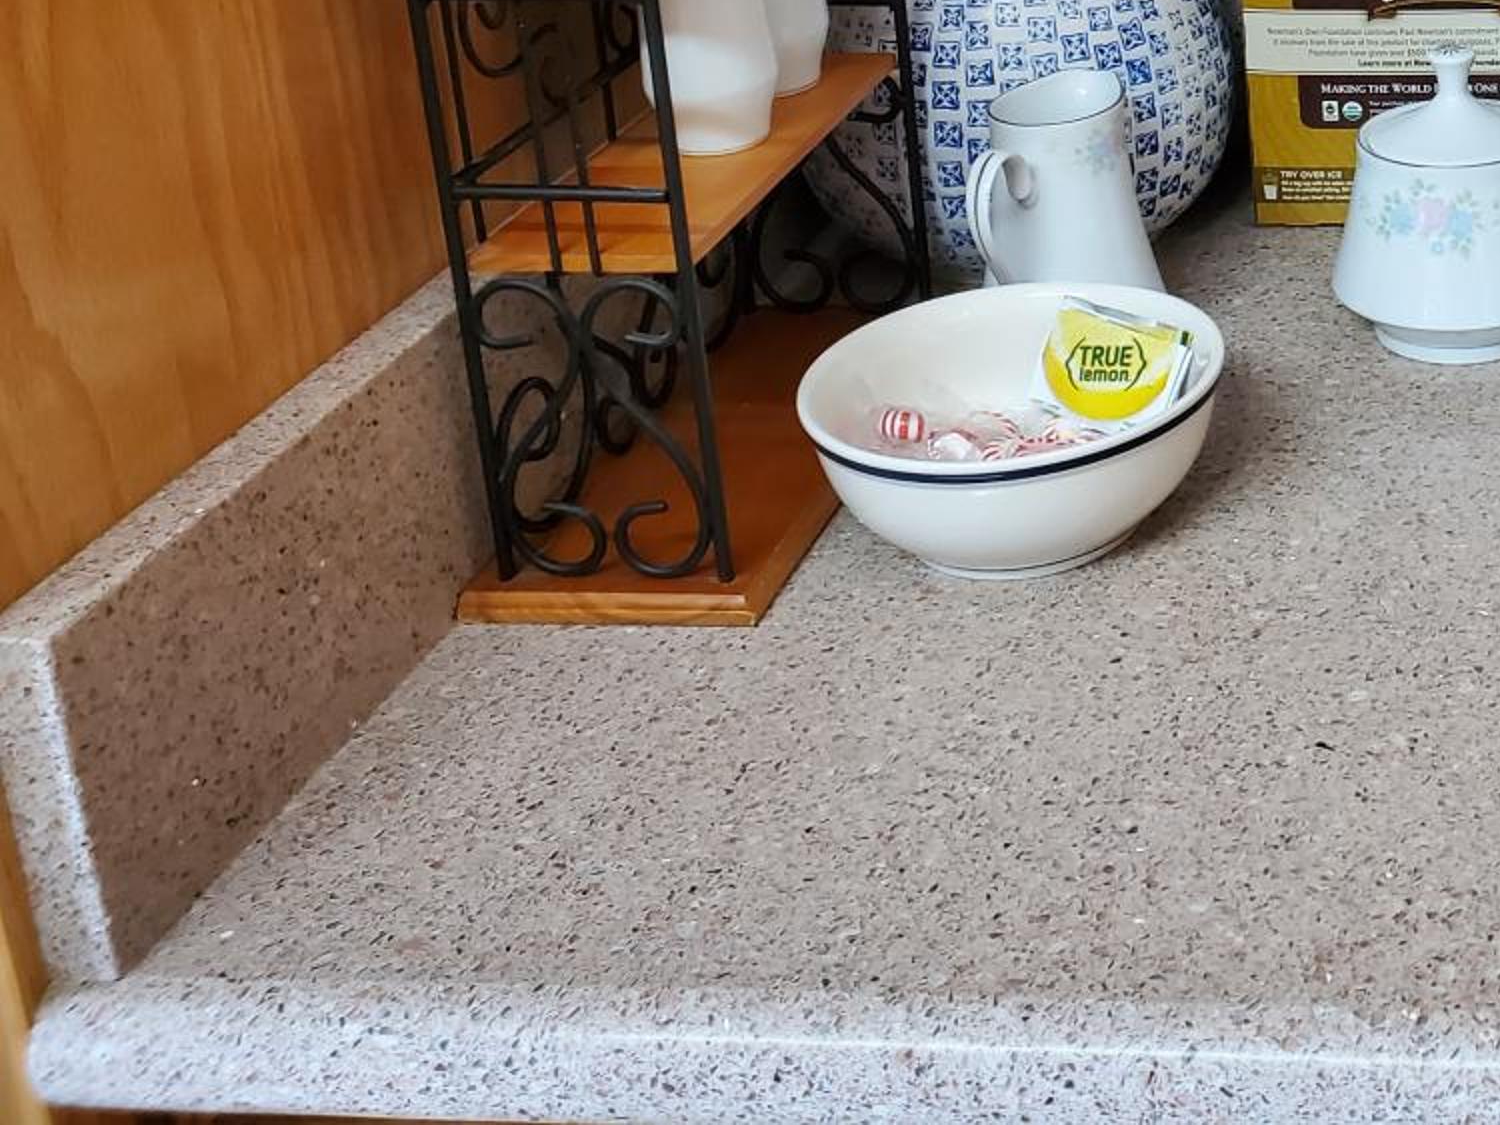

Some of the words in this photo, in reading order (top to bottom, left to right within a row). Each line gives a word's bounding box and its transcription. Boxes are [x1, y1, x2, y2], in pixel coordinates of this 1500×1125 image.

[1321, 82, 1368, 94] MAKING
[1368, 82, 1392, 94] THE
[1391, 82, 1433, 94] WORLD
[1279, 170, 1299, 179] TRY
[1299, 170, 1326, 179] OVER
[1327, 170, 1344, 179] ICE
[1079, 345, 1134, 367] TRUE
[1079, 367, 1130, 383] lemon
